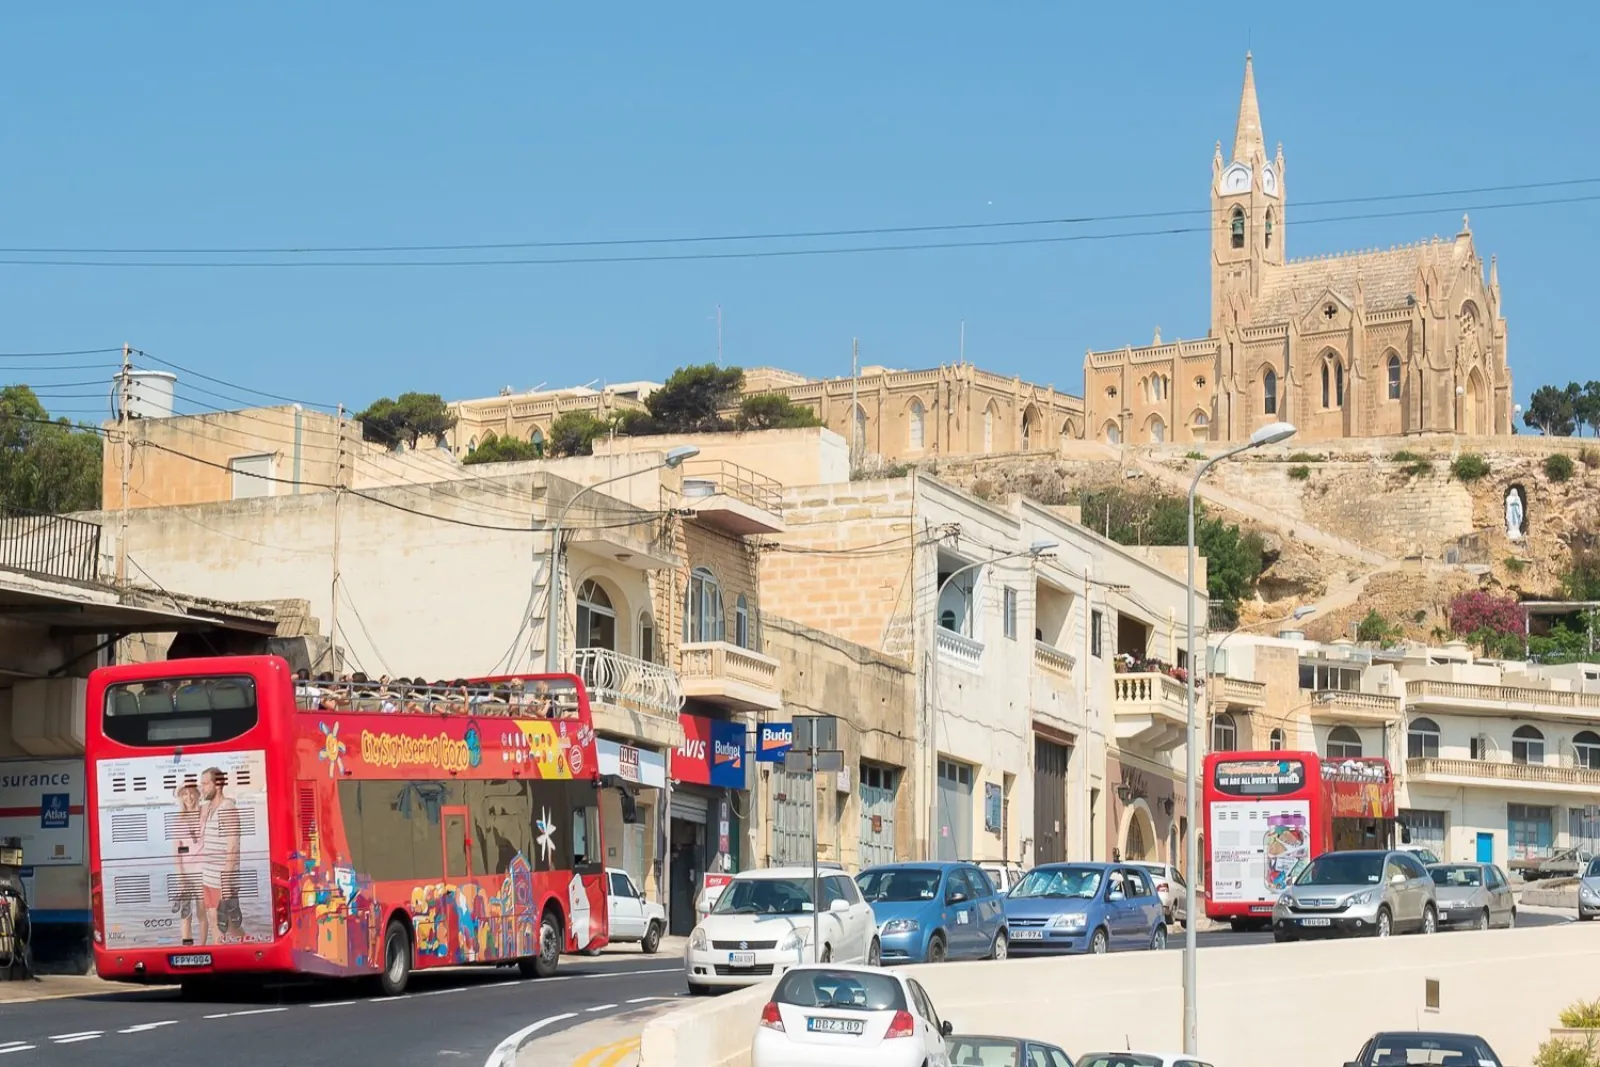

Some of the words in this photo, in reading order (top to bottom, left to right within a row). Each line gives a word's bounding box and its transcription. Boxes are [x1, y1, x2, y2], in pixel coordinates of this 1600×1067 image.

[763, 729, 792, 744] Budg
[677, 738, 706, 760] AVIS
[715, 740, 740, 759] Budget
[620, 747, 628, 762] TO
[628, 749, 639, 766] LET
[1241, 777, 1251, 785] ALL
[44, 809, 67, 819] Atlas
[144, 919, 172, 928] ecco
[839, 1020, 861, 1032] 189
